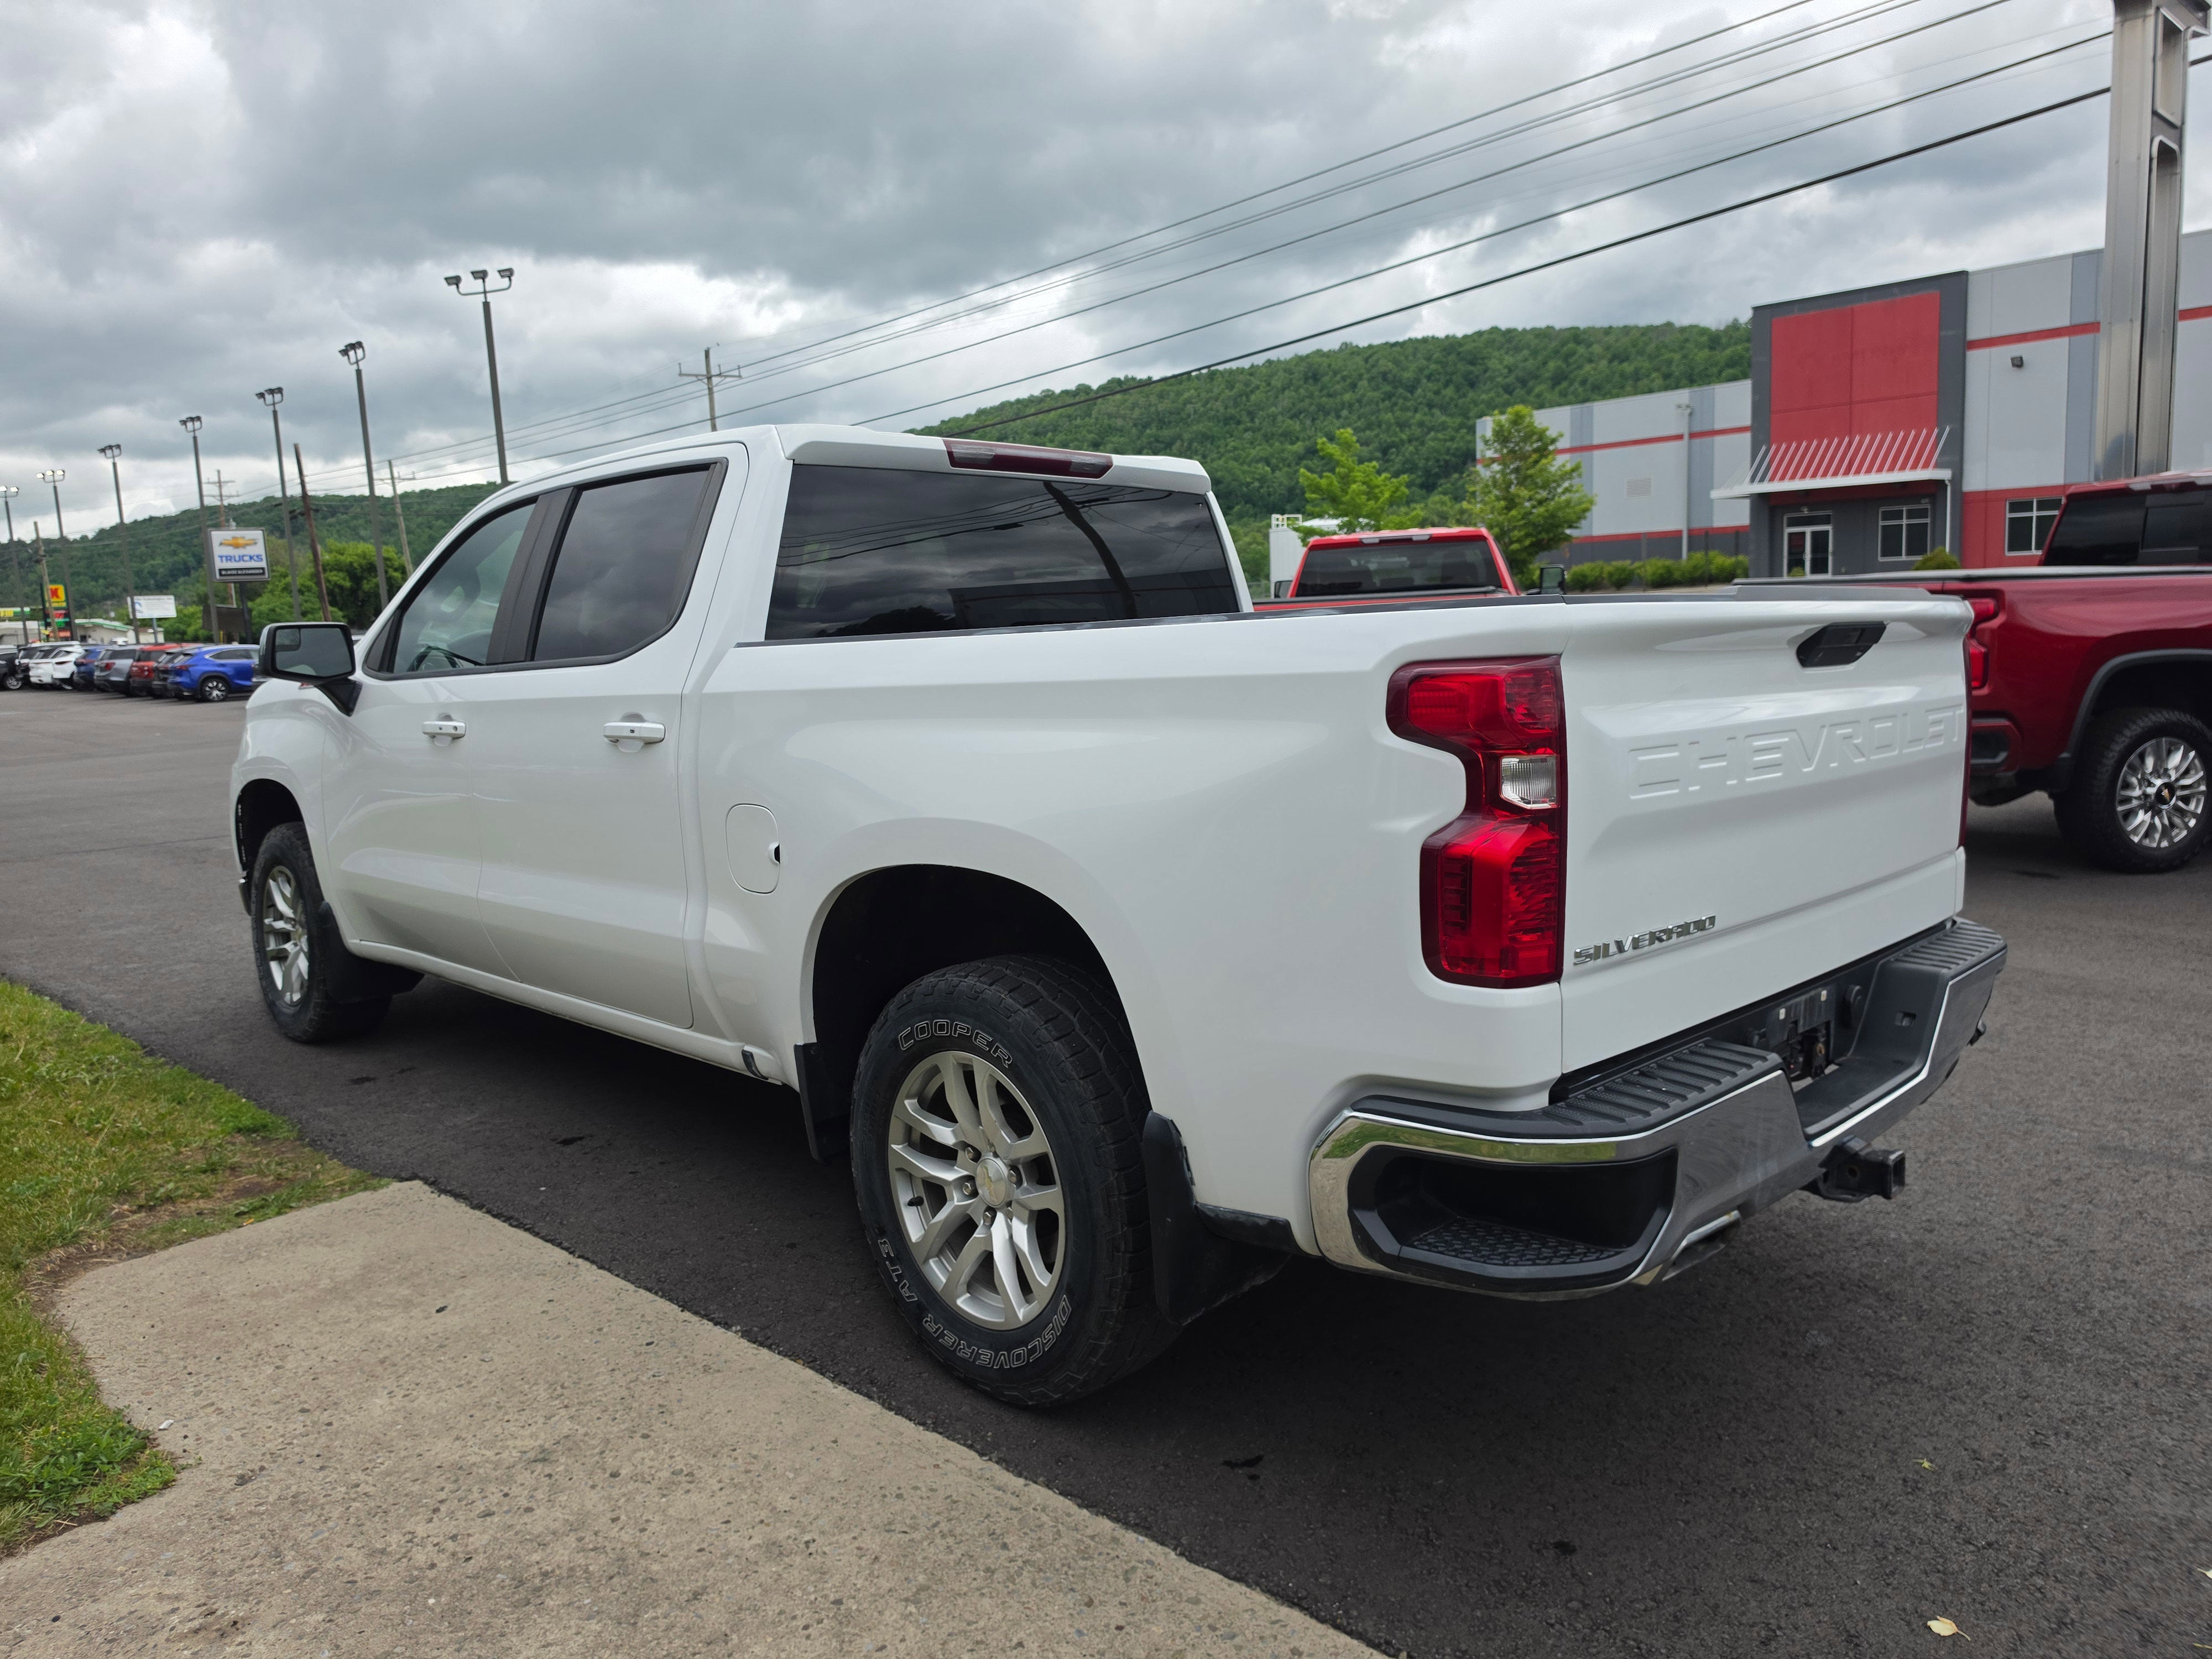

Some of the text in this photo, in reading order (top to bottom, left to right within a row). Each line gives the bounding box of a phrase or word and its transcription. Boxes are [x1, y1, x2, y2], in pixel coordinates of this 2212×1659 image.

[217, 554, 263, 563] TRUCKS
[1628, 703, 1964, 800] CHEVROLET
[1573, 914, 1716, 966] SILVERADO
[898, 1019, 1013, 1070] COOPER
[922, 1294, 1072, 1369] DISCOVERER
